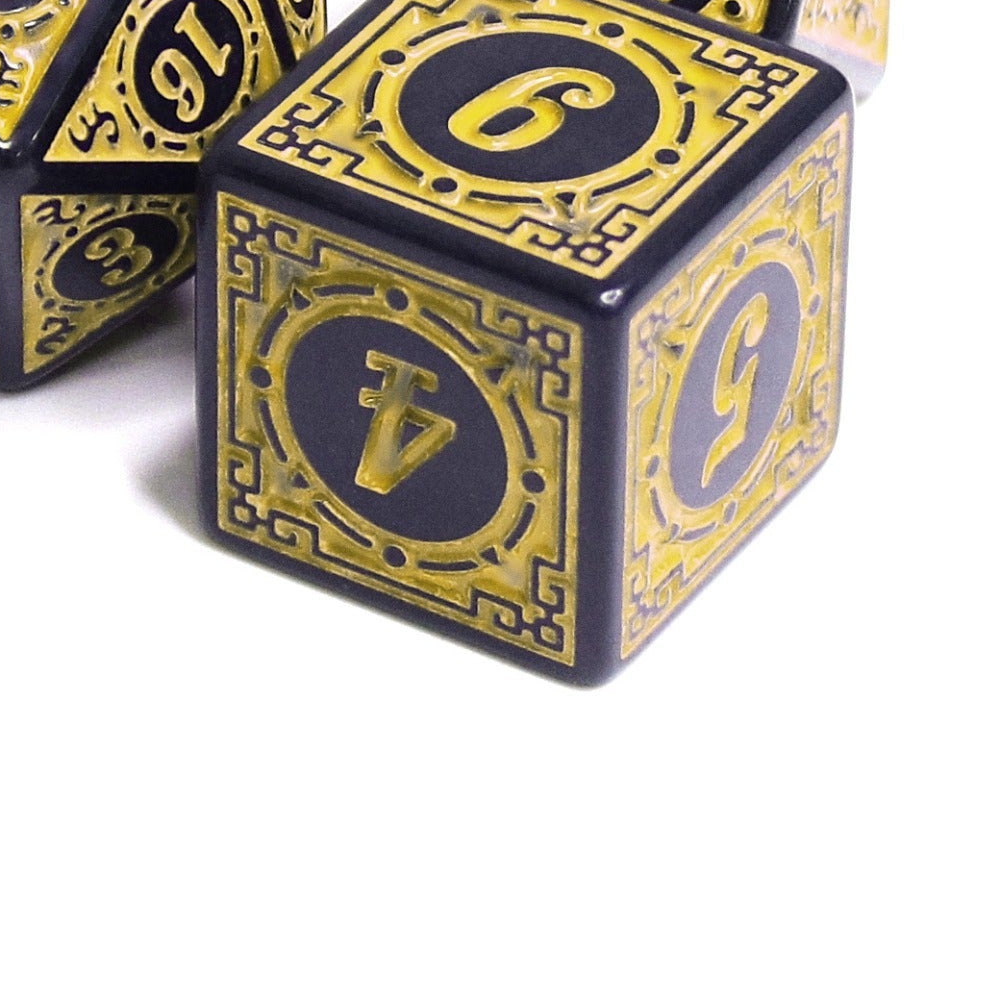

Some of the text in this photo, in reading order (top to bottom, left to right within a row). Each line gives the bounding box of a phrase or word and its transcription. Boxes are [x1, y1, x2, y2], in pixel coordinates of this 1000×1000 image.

[150, 1, 235, 123] 16
[448, 66, 616, 150] 6
[84, 226, 153, 287] 3
[353, 348, 456, 495] 4
[699, 291, 768, 490] 5
